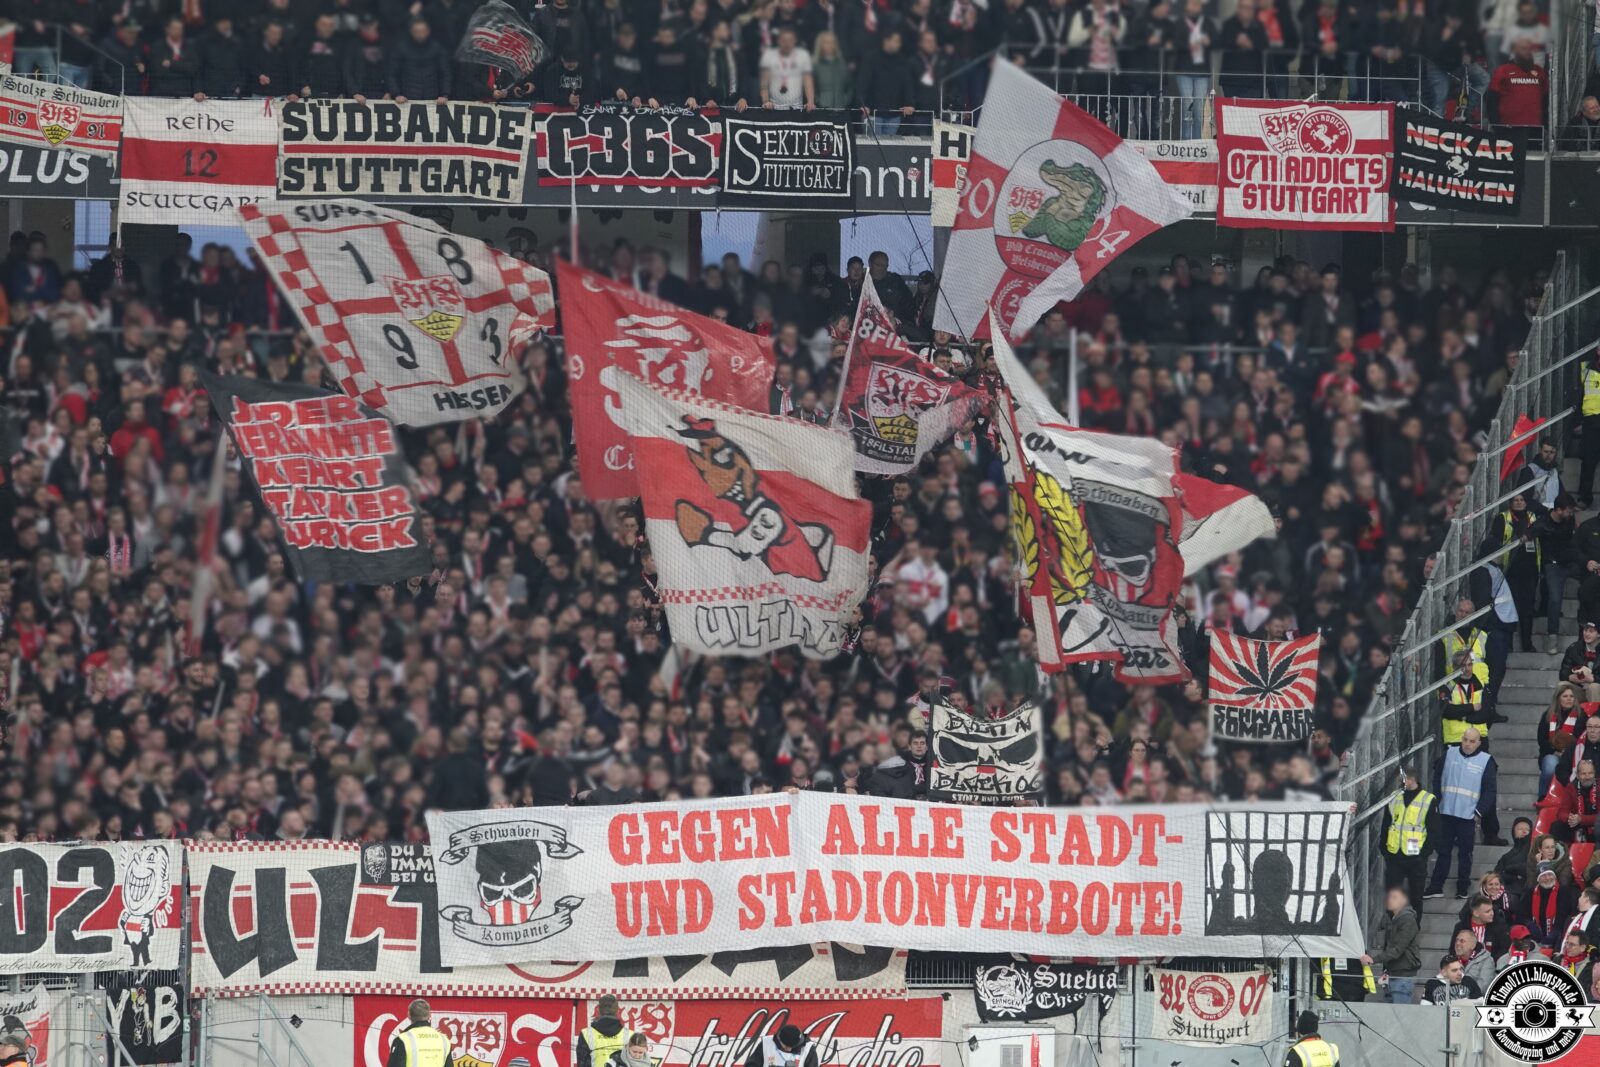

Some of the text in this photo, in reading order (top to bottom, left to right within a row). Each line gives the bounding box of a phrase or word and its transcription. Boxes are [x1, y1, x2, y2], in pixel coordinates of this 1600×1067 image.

[3, 77, 120, 109] Stolze Schwaben
[1510, 77, 1540, 85] WINAMAX
[8, 109, 105, 139] 19 91
[282, 100, 527, 151] SÜDBANDE
[1156, 143, 1208, 158] Oberes
[1406, 121, 1514, 161] NECKAR
[181, 147, 219, 178] 12
[1230, 152, 1384, 185] 0711 ADDICTS
[283, 157, 520, 200] STUTTGART
[1398, 165, 1516, 205] HALUNKEN
[1242, 183, 1370, 214] STUTTGART
[1213, 704, 1315, 723] SCHWABEN
[469, 824, 541, 844] Schwaben
[607, 803, 1185, 868] GEGEN ALLE STADT-
[391, 844, 415, 857] DU
[391, 857, 434, 871] IMM
[390, 872, 417, 883] BEI
[610, 867, 1184, 939] UND STADIONVERBOTE!
[480, 923, 551, 942] Kompanie
[1033, 964, 1118, 988] Suebia
[1451, 1010, 1461, 1018] 22
[1167, 1015, 1250, 1044] Stuttgart
